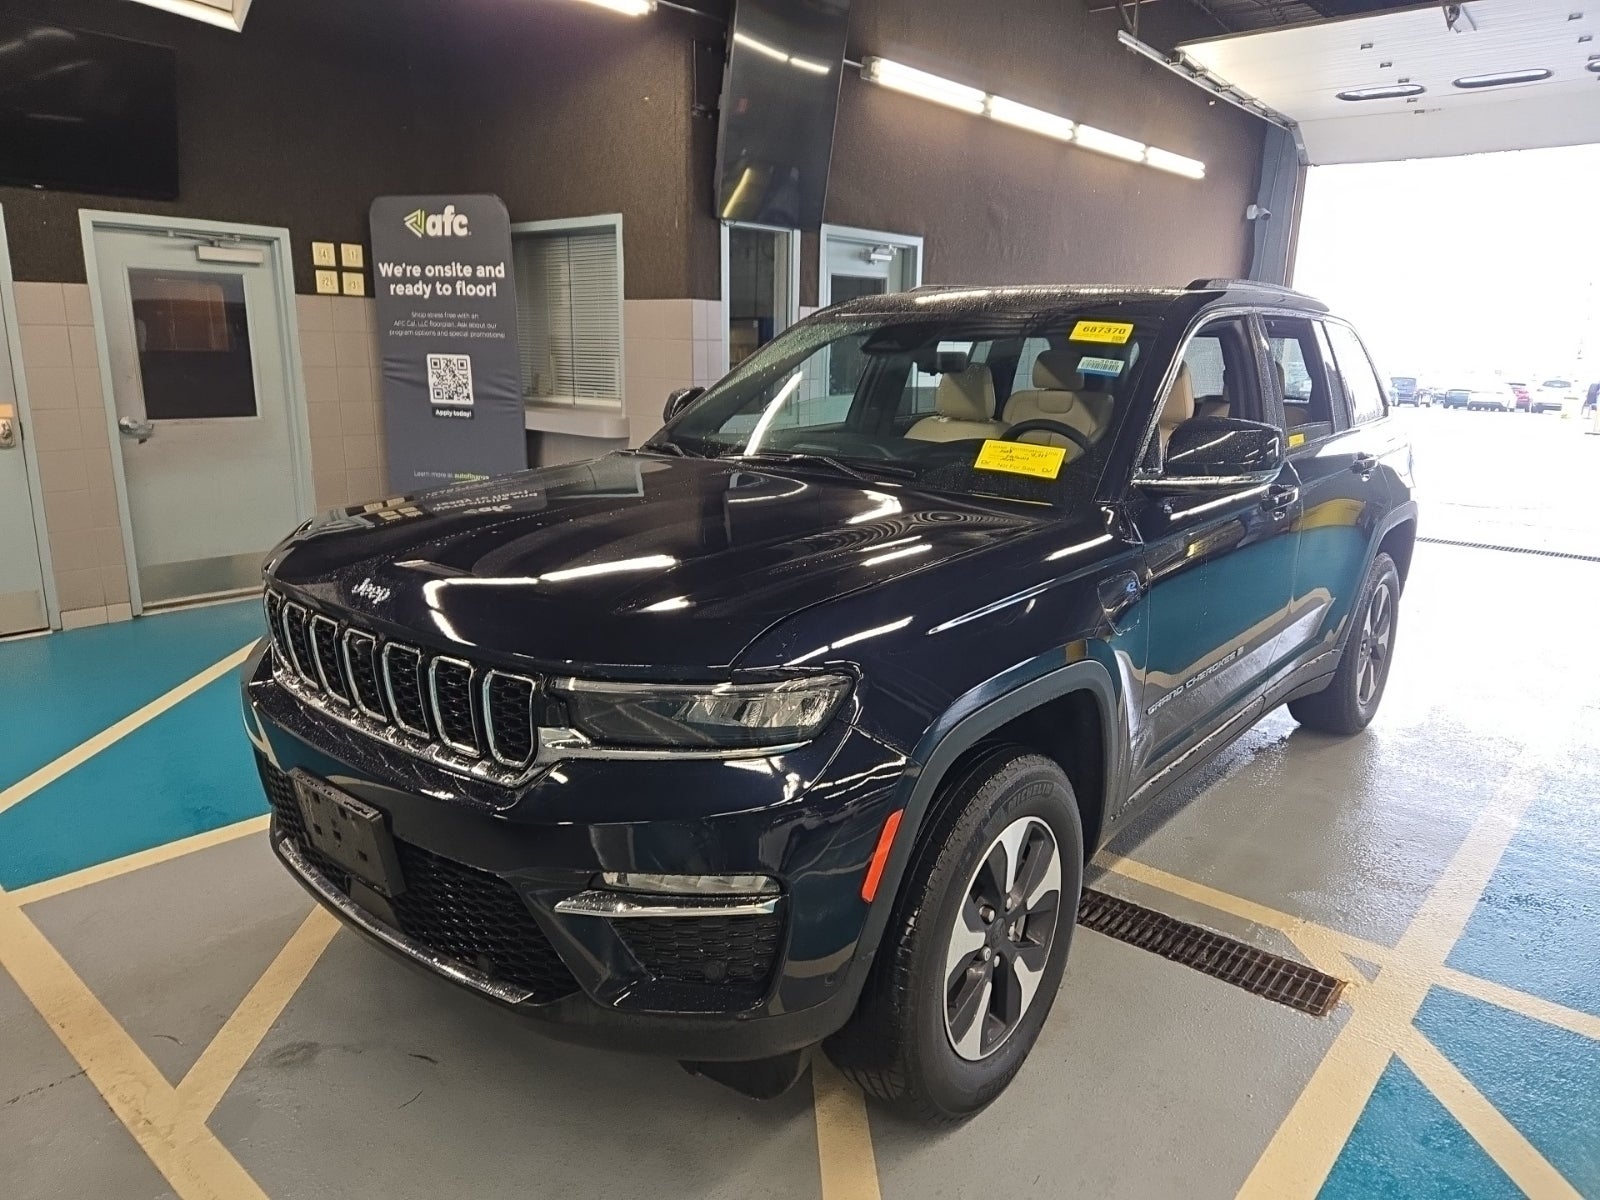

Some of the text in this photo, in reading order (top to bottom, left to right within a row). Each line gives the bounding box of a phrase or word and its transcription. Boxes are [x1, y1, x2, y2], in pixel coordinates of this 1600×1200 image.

[426, 204, 469, 237] afc
[378, 261, 505, 278] We're onsite and
[390, 280, 497, 299] ready to floor!
[1082, 326, 1126, 334] 687370
[436, 409, 472, 418] Apply today!
[352, 578, 390, 604] Jeep
[1147, 651, 1237, 715] GRAND CHEROKEE
